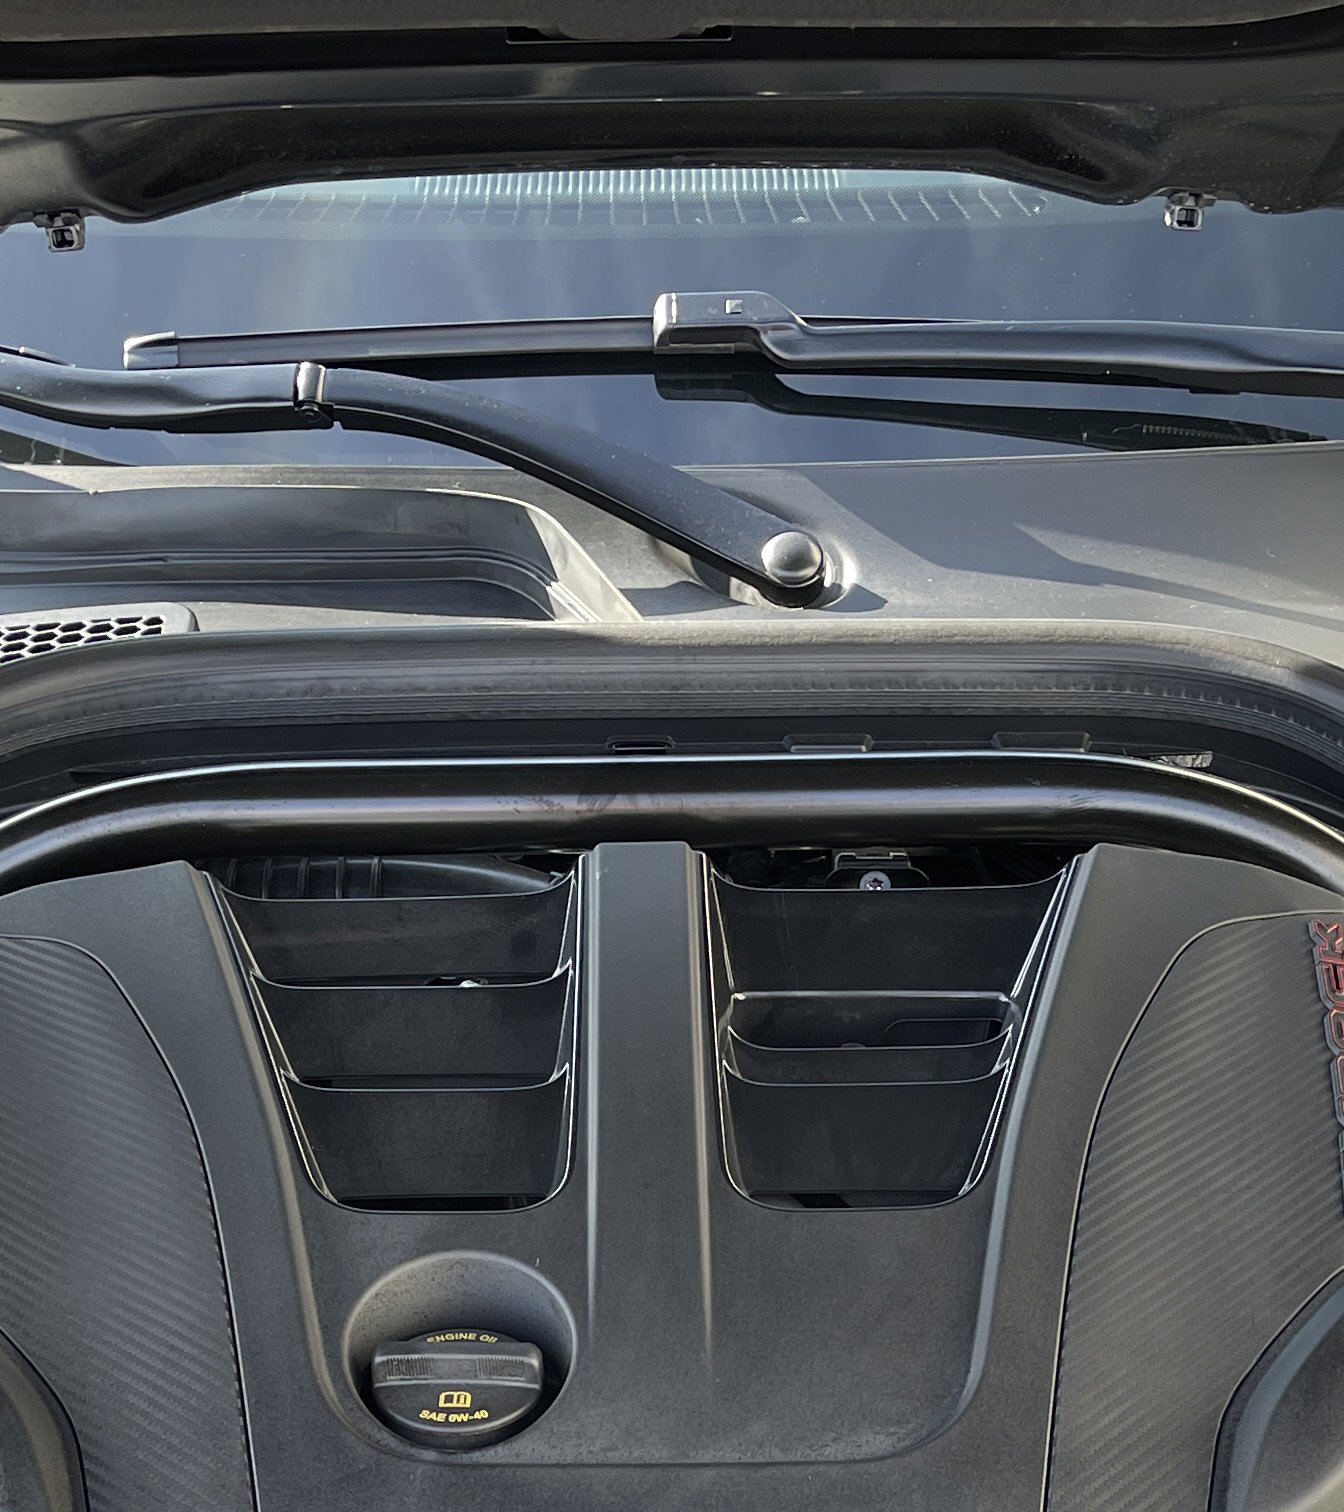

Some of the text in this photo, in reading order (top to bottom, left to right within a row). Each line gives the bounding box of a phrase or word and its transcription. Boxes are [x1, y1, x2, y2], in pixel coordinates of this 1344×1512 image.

[426, 1332, 477, 1343] ENGINE
[419, 1409, 489, 1422] SAE 0W-40
